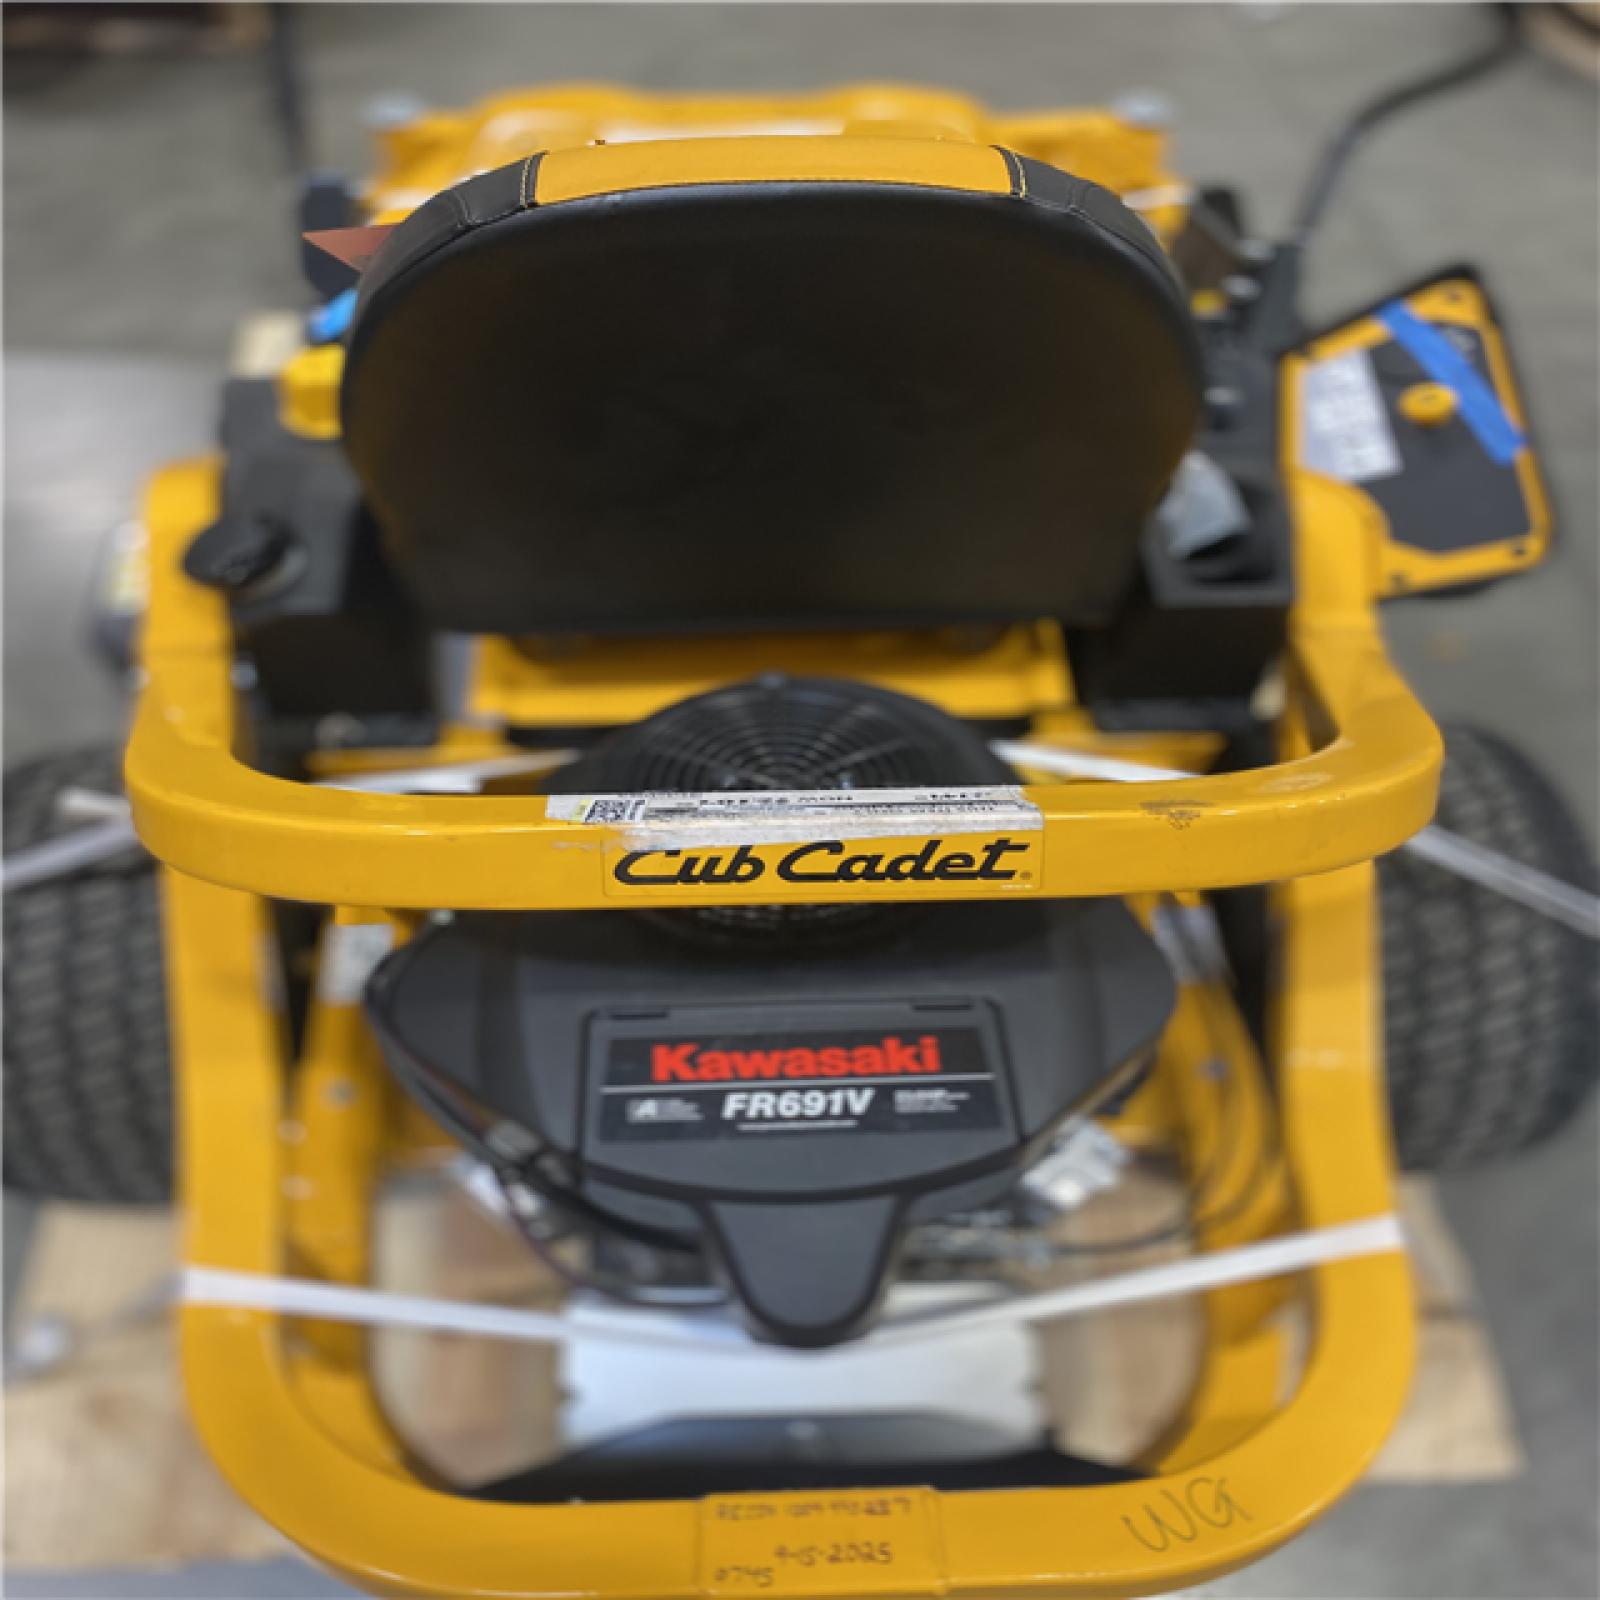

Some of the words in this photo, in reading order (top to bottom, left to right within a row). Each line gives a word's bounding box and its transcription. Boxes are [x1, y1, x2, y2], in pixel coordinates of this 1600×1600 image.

[613, 844, 766, 886] Cub
[776, 838, 1031, 883] Cadet
[651, 1034, 941, 1083] Kawasaki
[721, 1087, 876, 1120] FR691V
